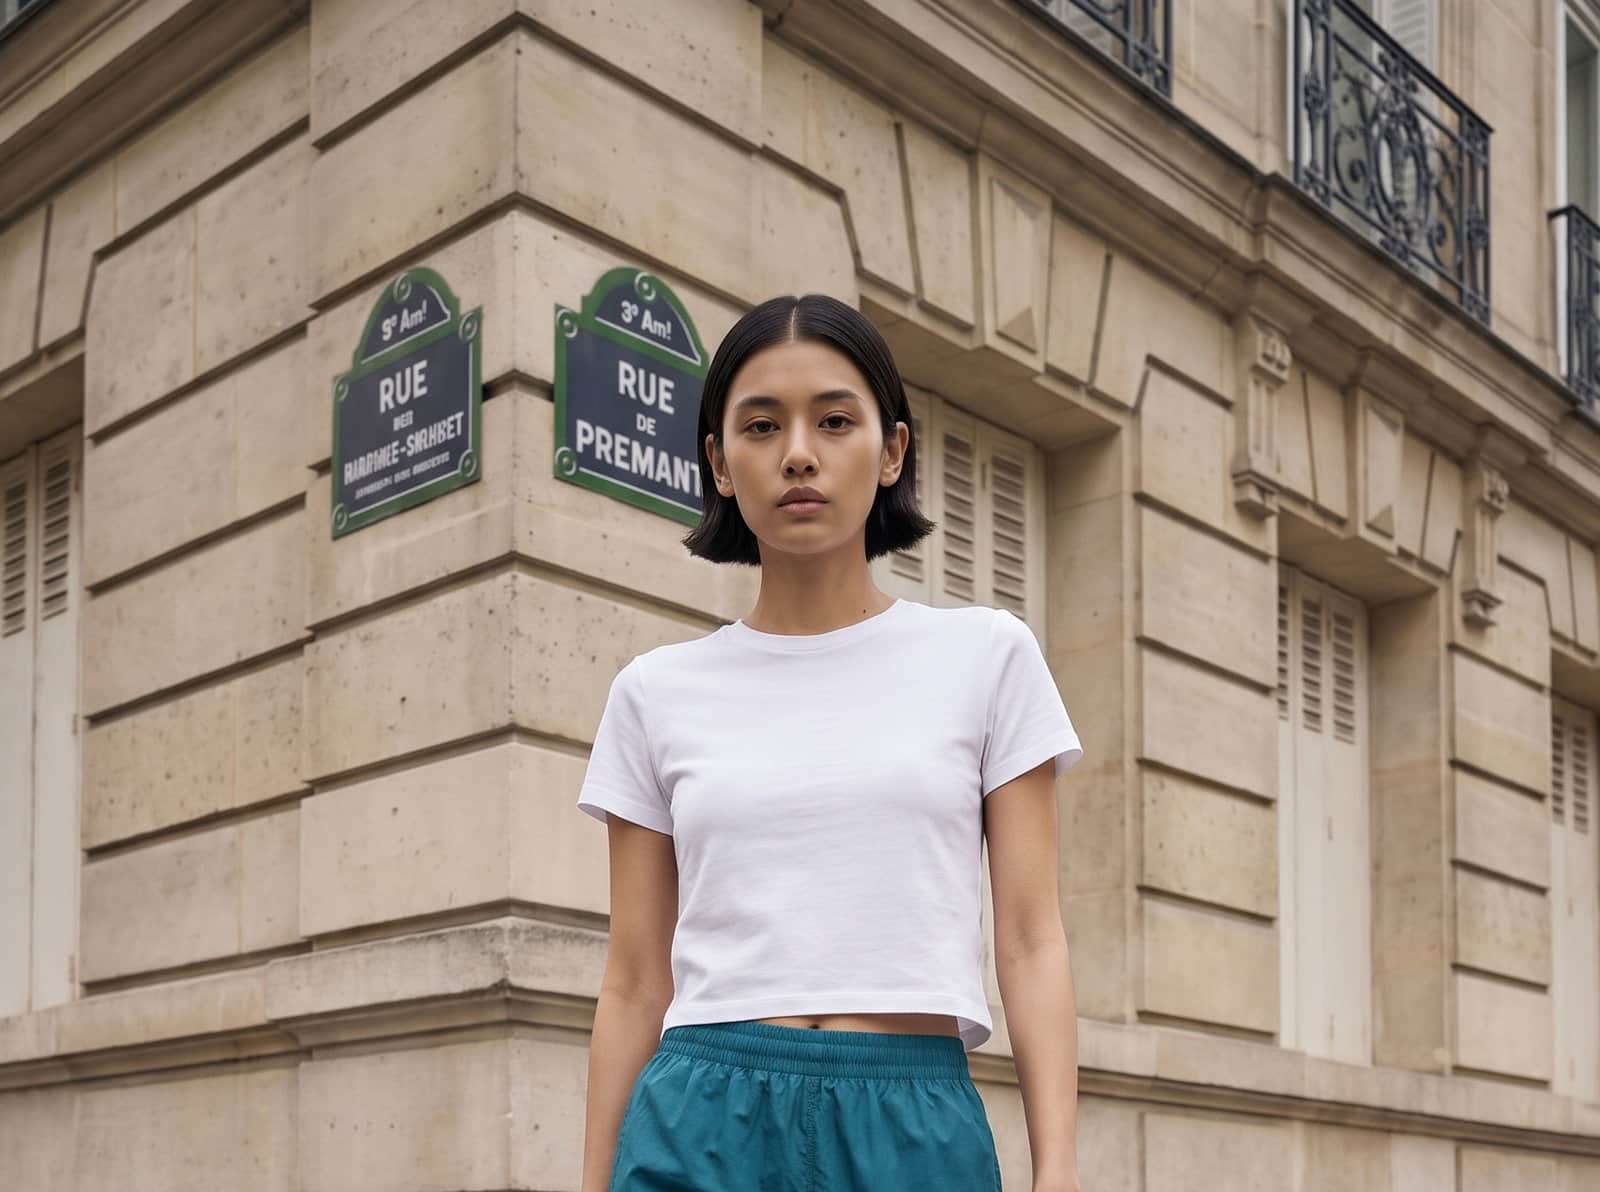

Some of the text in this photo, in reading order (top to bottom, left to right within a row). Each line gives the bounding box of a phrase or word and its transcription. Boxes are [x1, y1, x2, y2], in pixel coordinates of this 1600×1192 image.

[379, 360, 428, 413] RUE
[617, 360, 675, 415] RUE
[636, 413, 657, 437] DE
